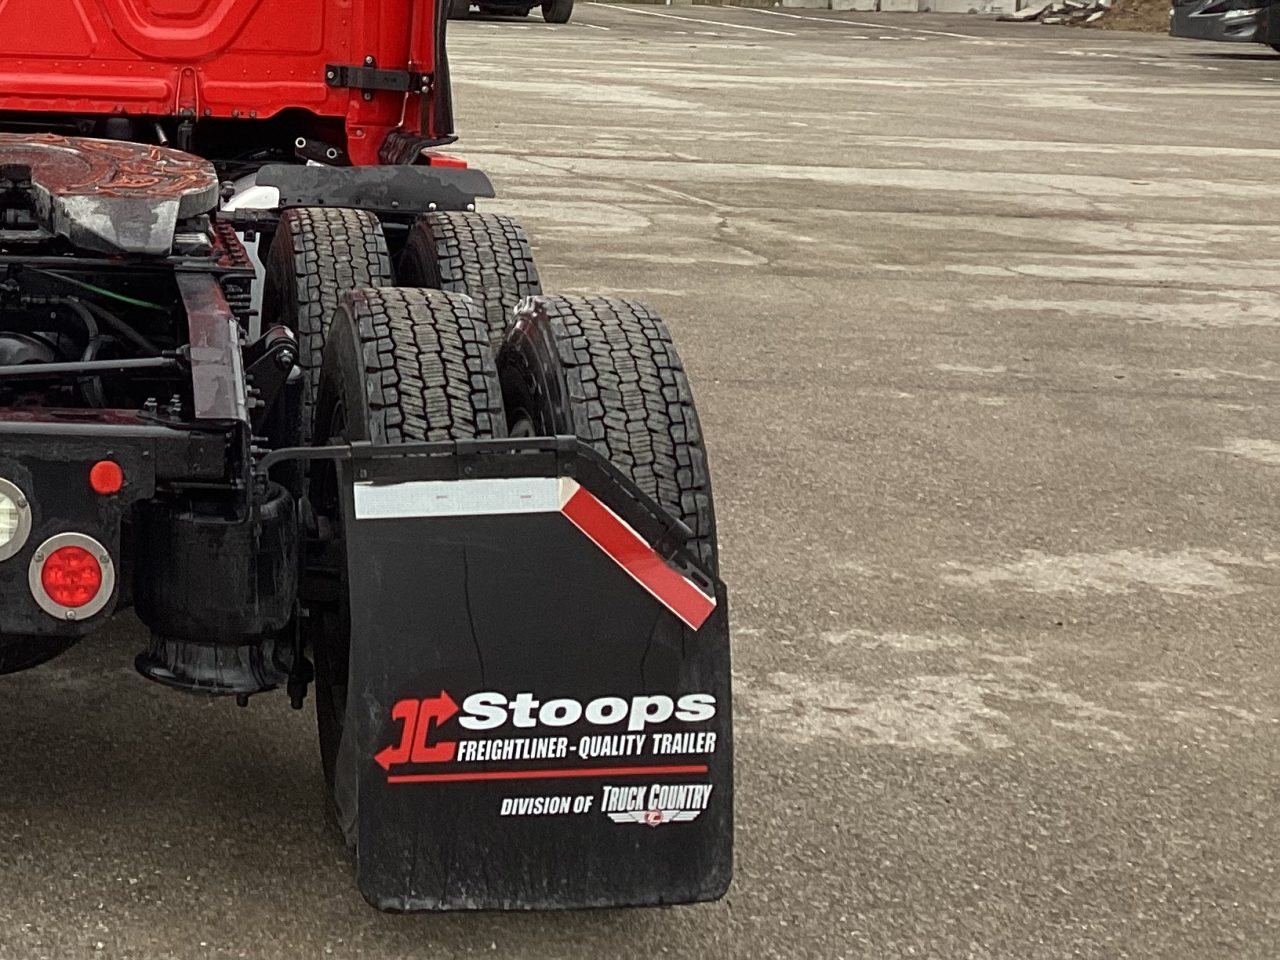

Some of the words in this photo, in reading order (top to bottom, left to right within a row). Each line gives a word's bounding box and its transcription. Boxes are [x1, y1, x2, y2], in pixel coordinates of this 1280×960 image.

[458, 691, 717, 732] Stoops
[652, 732, 717, 755] TRAILER
[500, 796, 572, 816] DIVISION
[573, 795, 594, 814] OF
[601, 785, 648, 811] TRUCK
[647, 783, 713, 811] COUNTRY
